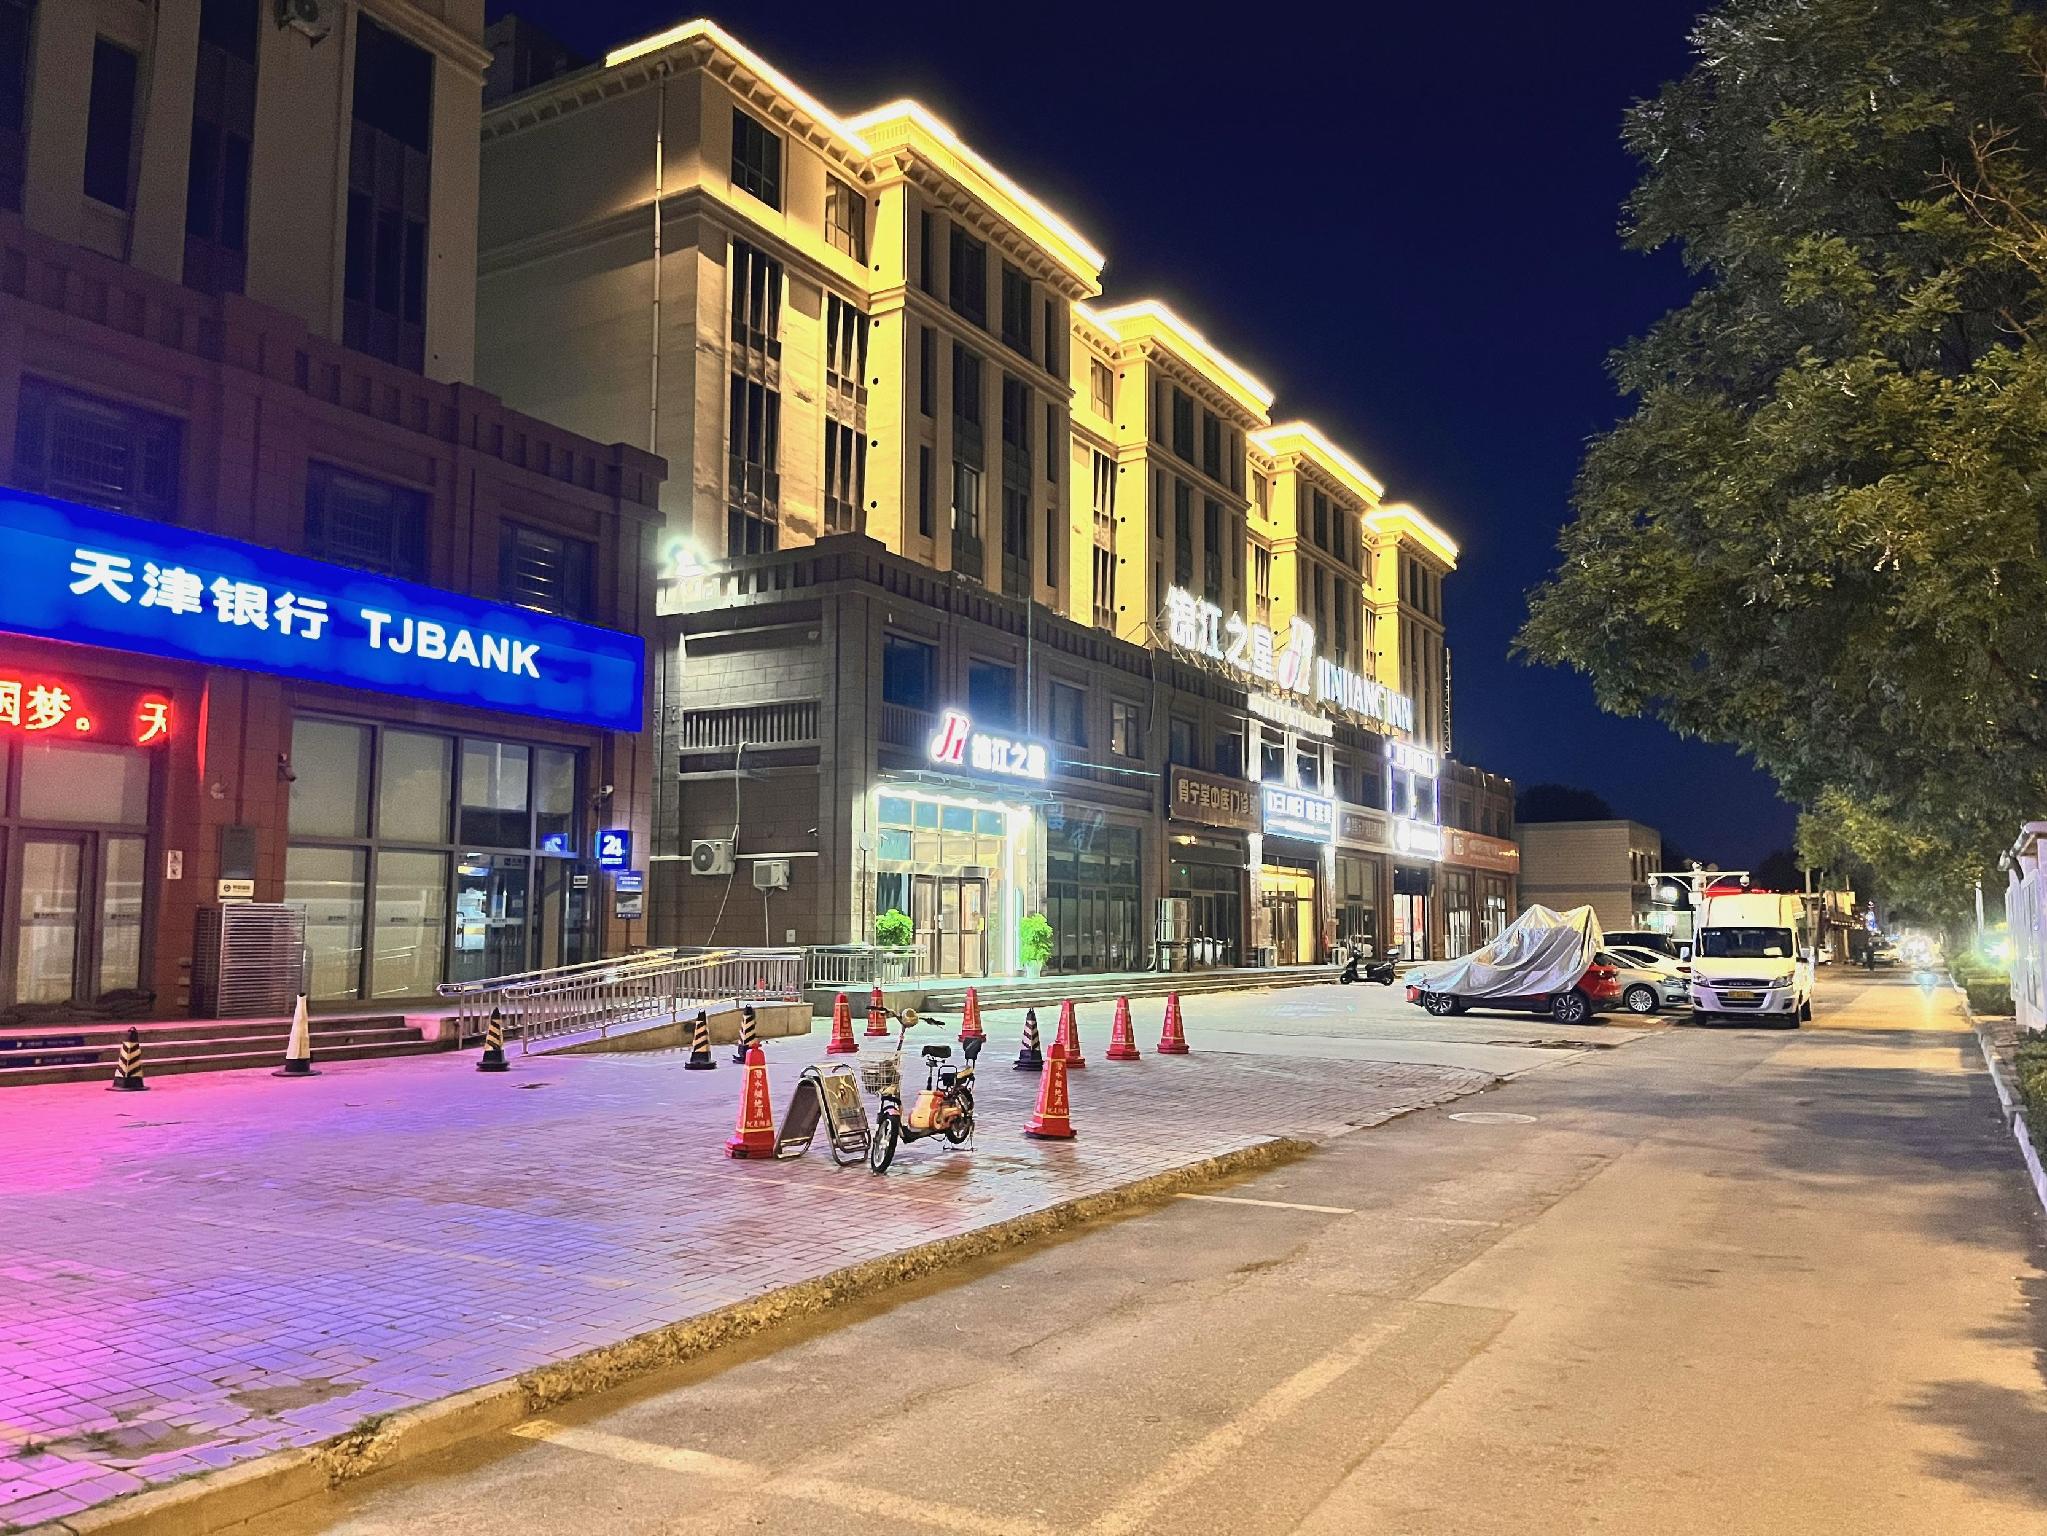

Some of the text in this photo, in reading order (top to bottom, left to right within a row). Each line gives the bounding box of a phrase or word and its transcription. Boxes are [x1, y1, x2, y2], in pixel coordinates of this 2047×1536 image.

[69, 548, 541, 679] 天津银行 TJBANK
[1168, 584, 1274, 681] 锦江之星
